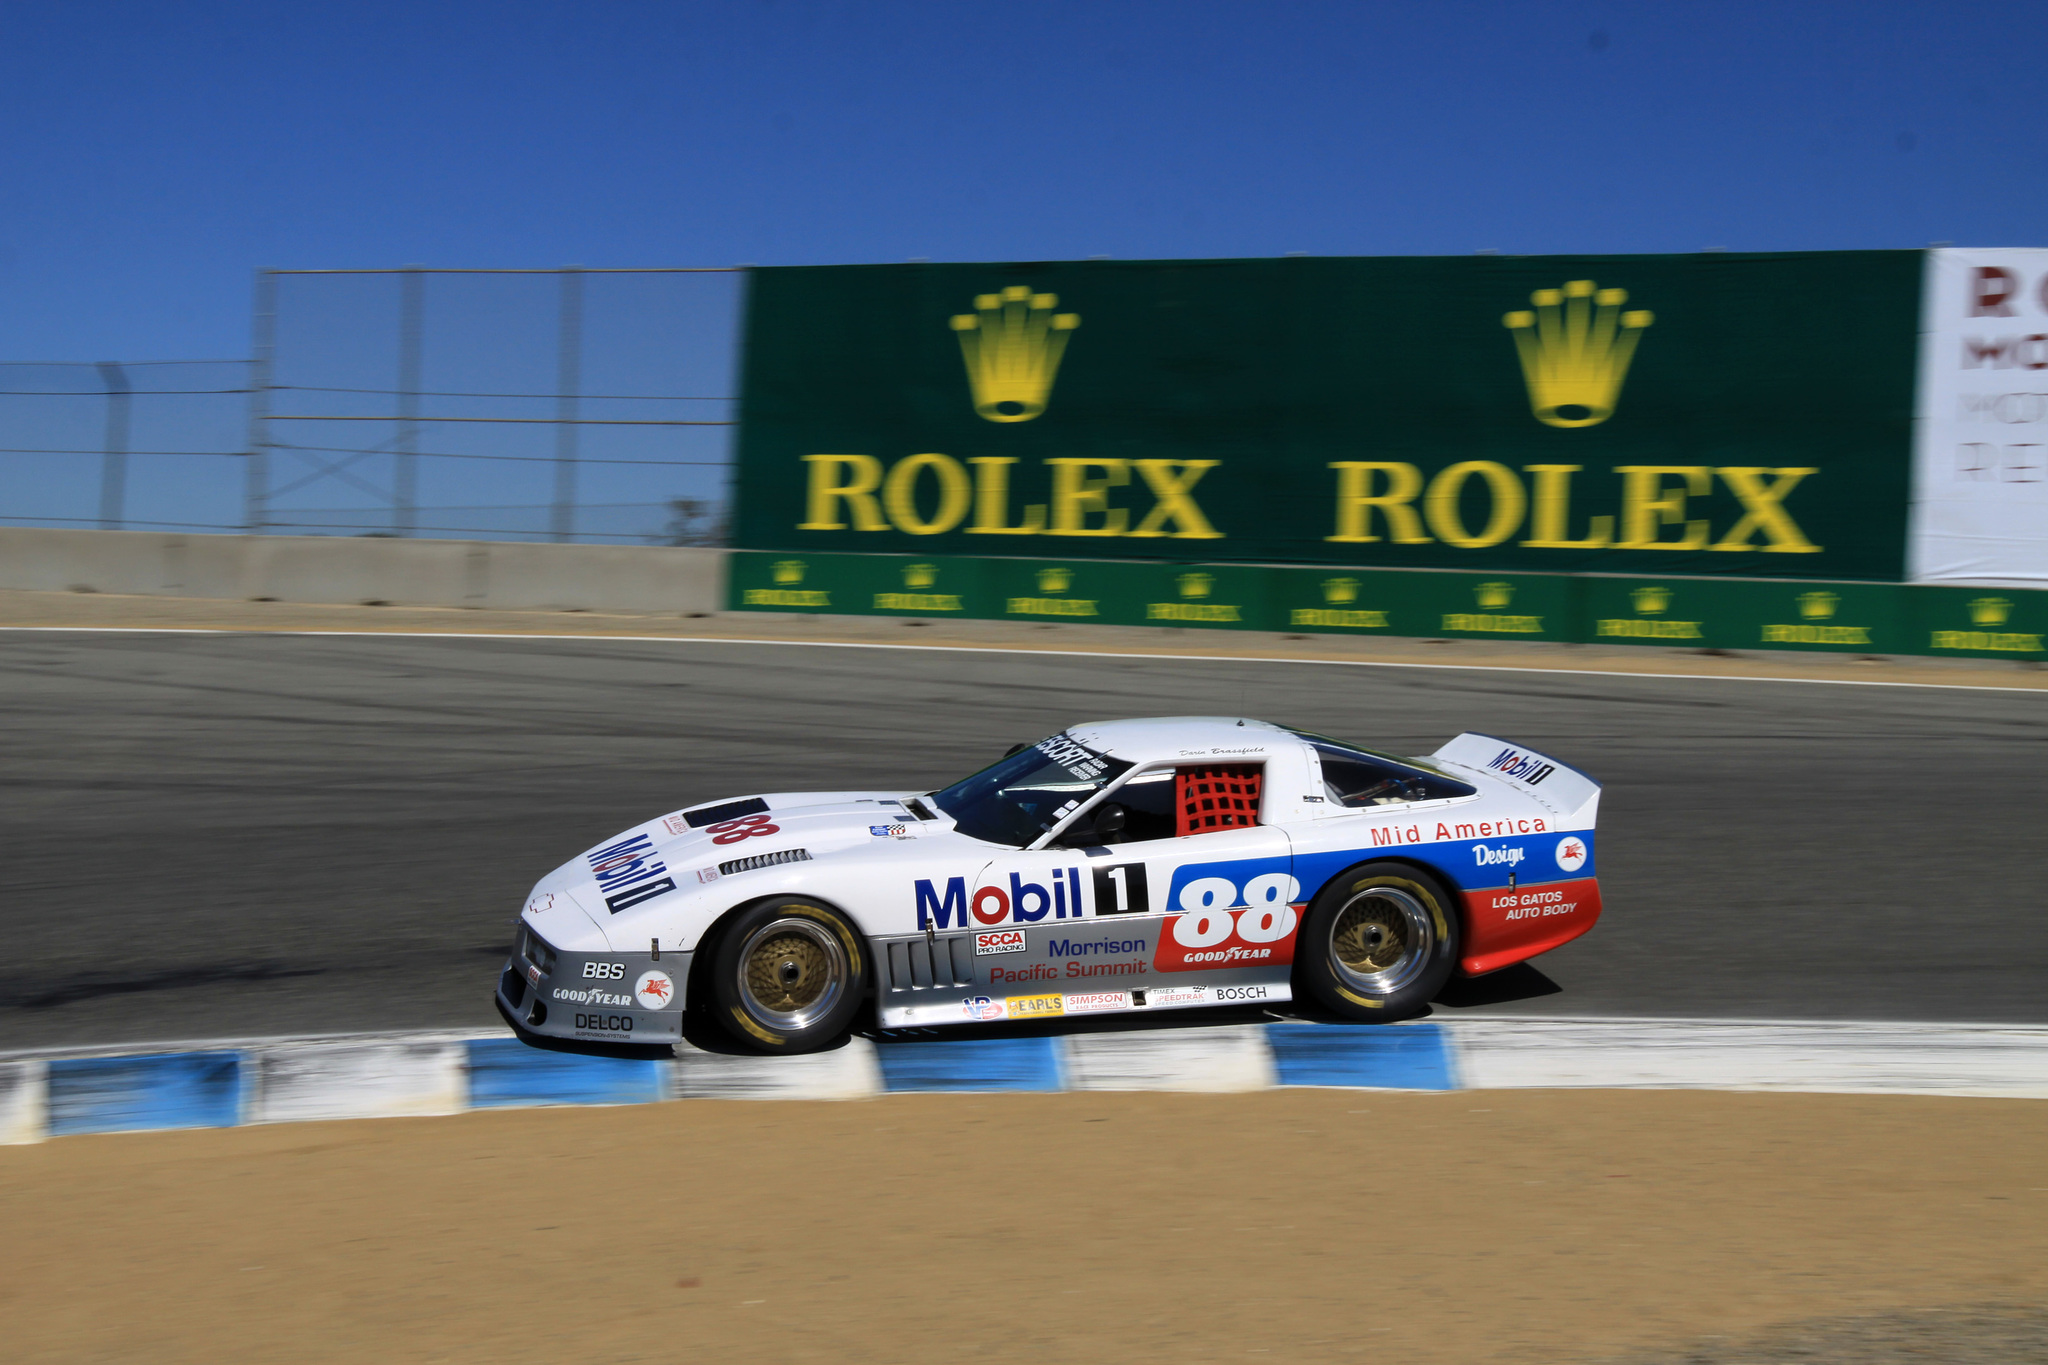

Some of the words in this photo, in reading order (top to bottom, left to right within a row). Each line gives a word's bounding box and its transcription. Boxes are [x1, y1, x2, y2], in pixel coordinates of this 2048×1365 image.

[796, 453, 1226, 539] ROLEX
[1323, 460, 1824, 553] ROLEX
[1487, 749, 1540, 780] Mobil
[705, 814, 780, 845] 88
[1371, 824, 1421, 846] Mid
[1435, 818, 1546, 841] America
[587, 833, 667, 893] Mobil
[1472, 844, 1525, 867] Design
[914, 867, 1082, 931] Mobil
[1108, 867, 1129, 911] 1
[1173, 873, 1300, 948] 88
[1492, 895, 1518, 909] LOS
[1520, 891, 1563, 906] GATOS
[1506, 907, 1540, 921] AUTO
[1542, 902, 1577, 917] BODY
[978, 932, 1023, 947] SCCA
[978, 946, 994, 955] PRO
[995, 944, 1024, 953] RACING
[1049, 937, 1146, 957] Morrison
[582, 961, 626, 980] BBS
[990, 963, 1058, 984] Pacific
[1066, 958, 1147, 978] Summit
[1018, 997, 1062, 1011] EARL'S
[1069, 994, 1123, 1005] SIMPSON
[1217, 987, 1267, 1000] BOSCH
[962, 996, 991, 1020] VP
[575, 1013, 633, 1031] DELCO
